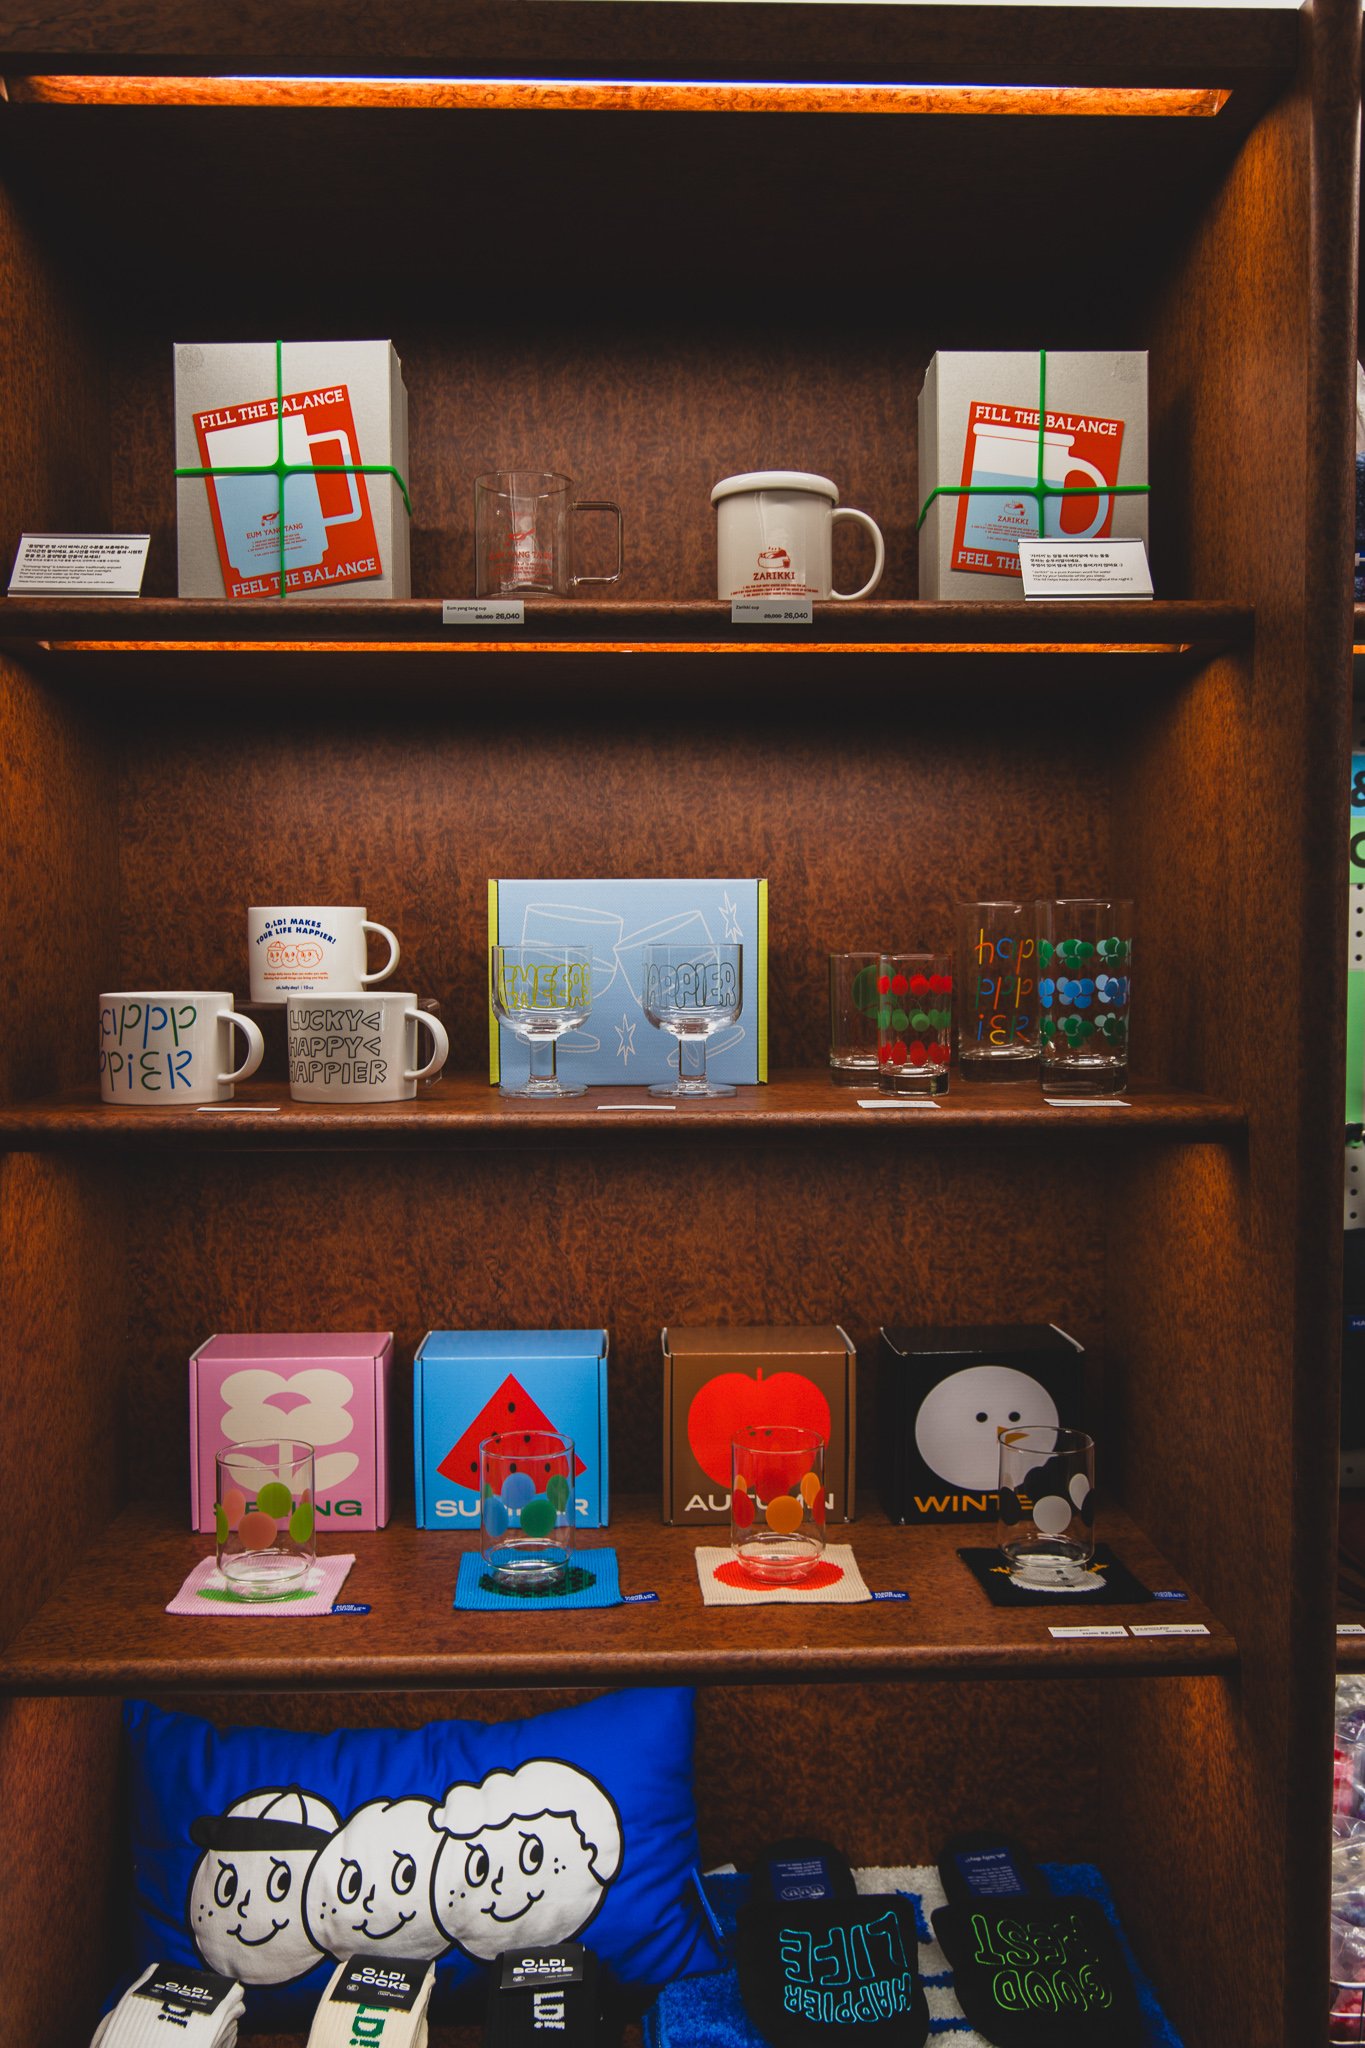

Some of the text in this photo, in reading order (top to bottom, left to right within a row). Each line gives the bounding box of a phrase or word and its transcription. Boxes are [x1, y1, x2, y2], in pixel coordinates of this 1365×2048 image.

[199, 388, 345, 429] FILL THE BALANCE
[975, 405, 1118, 436] FILL THE BALANCE
[997, 515, 1030, 525] ZARIKKI
[263, 527, 280, 536] YAN
[957, 551, 992, 567] FEEL
[231, 557, 377, 597] FEEL THE BALANCE
[753, 572, 795, 581] ZARIKKI
[290, 918, 322, 928] MAKES
[256, 926, 337, 945] YOUR LIFE HAPPIER!
[643, 962, 736, 1009] APPIER
[913, 1494, 1034, 1513] WINTE
[779, 1911, 908, 1986] LIFE
[513, 1966, 574, 1974] SOCKS
[521, 1958, 566, 1968] O,LD!
[350, 1973, 411, 1991] SOCKS
[362, 1967, 406, 1982] O,LD!
[153, 1983, 214, 2001] SOCKS
[165, 1981, 209, 1996] O,LD!
[783, 1971, 913, 2024] HAPPIER
